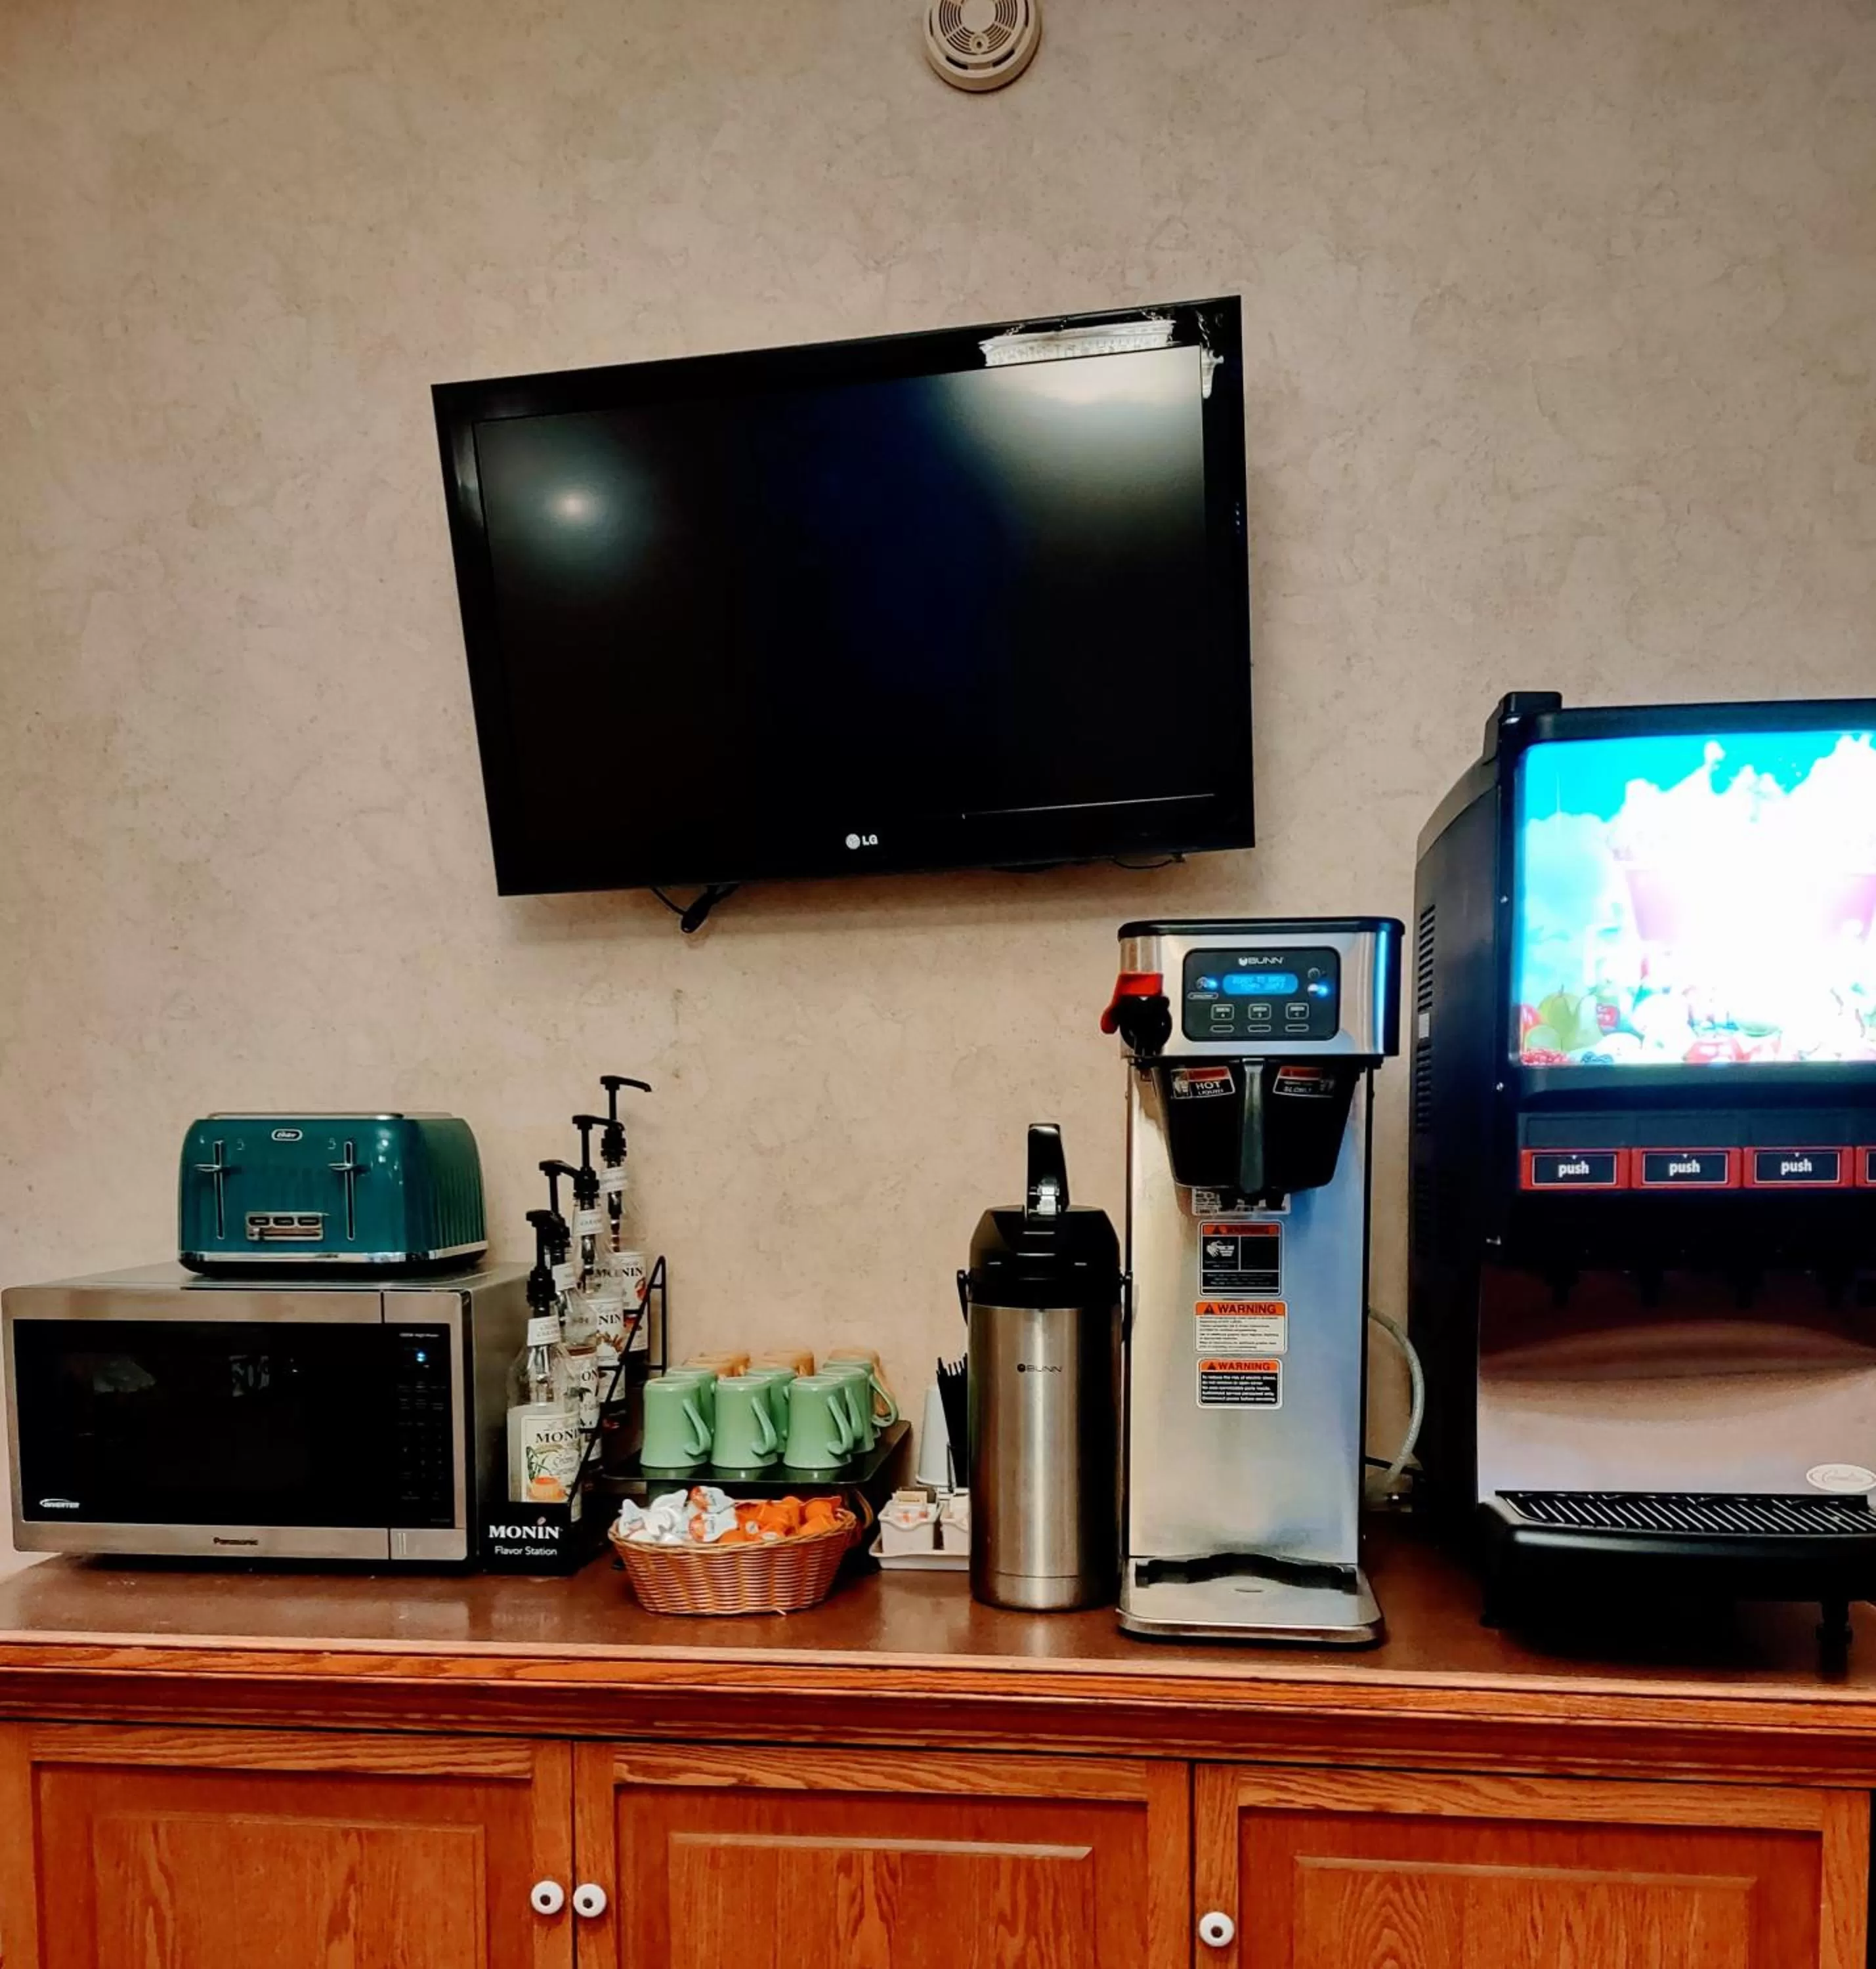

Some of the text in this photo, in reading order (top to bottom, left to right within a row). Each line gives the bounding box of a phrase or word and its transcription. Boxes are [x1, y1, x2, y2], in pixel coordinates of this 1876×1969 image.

[1248, 956, 1284, 965] BUNN
[1195, 1081, 1220, 1090] HOT
[1558, 1162, 1589, 1178] push
[1669, 1160, 1700, 1176] push
[1780, 1158, 1812, 1175] push
[1218, 1304, 1276, 1314] WARNING
[1218, 1362, 1271, 1371] WARNING
[495, 1546, 557, 1556] Flavor Station
